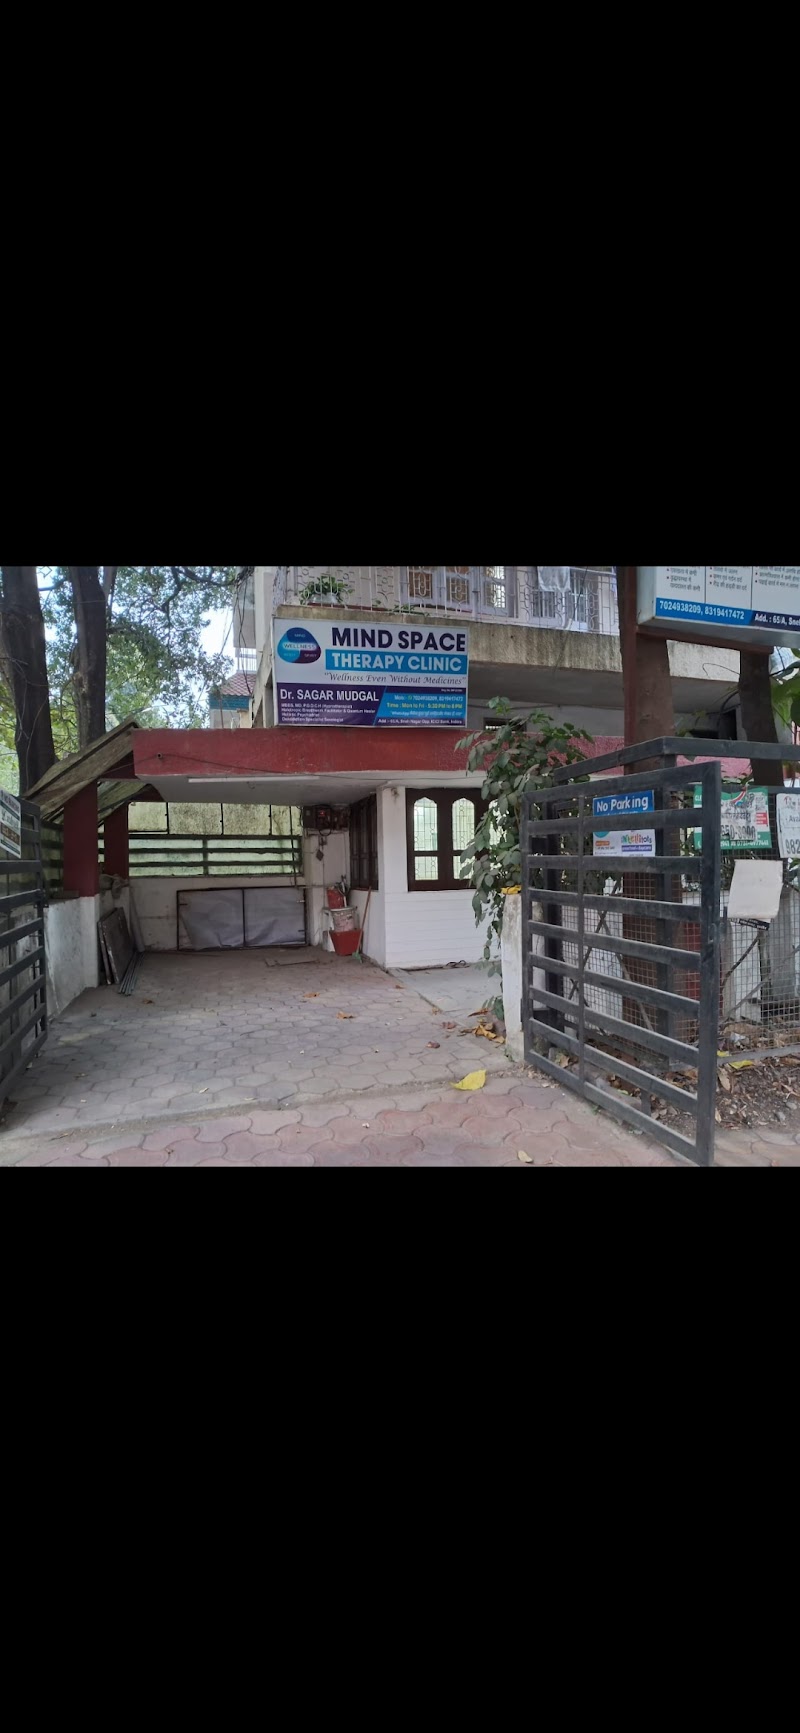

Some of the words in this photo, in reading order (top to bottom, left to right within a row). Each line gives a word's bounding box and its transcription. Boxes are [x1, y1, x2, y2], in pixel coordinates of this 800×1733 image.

[659, 601, 703, 616] 7024938209,
[705, 607, 744, 620] 8319417472
[755, 613, 767, 623] Add.
[332, 627, 392, 650] MIND
[398, 632, 465, 651] SPACE
[332, 653, 403, 670] THERAPY
[408, 657, 462, 671] CLINIC
[390, 675, 421, 684] Without
[280, 689, 294, 699] Dr.
[297, 690, 334, 700] SAGAR
[337, 691, 379, 702] MUDGAL
[597, 801, 608, 812] No
[611, 796, 648, 810] Parking
